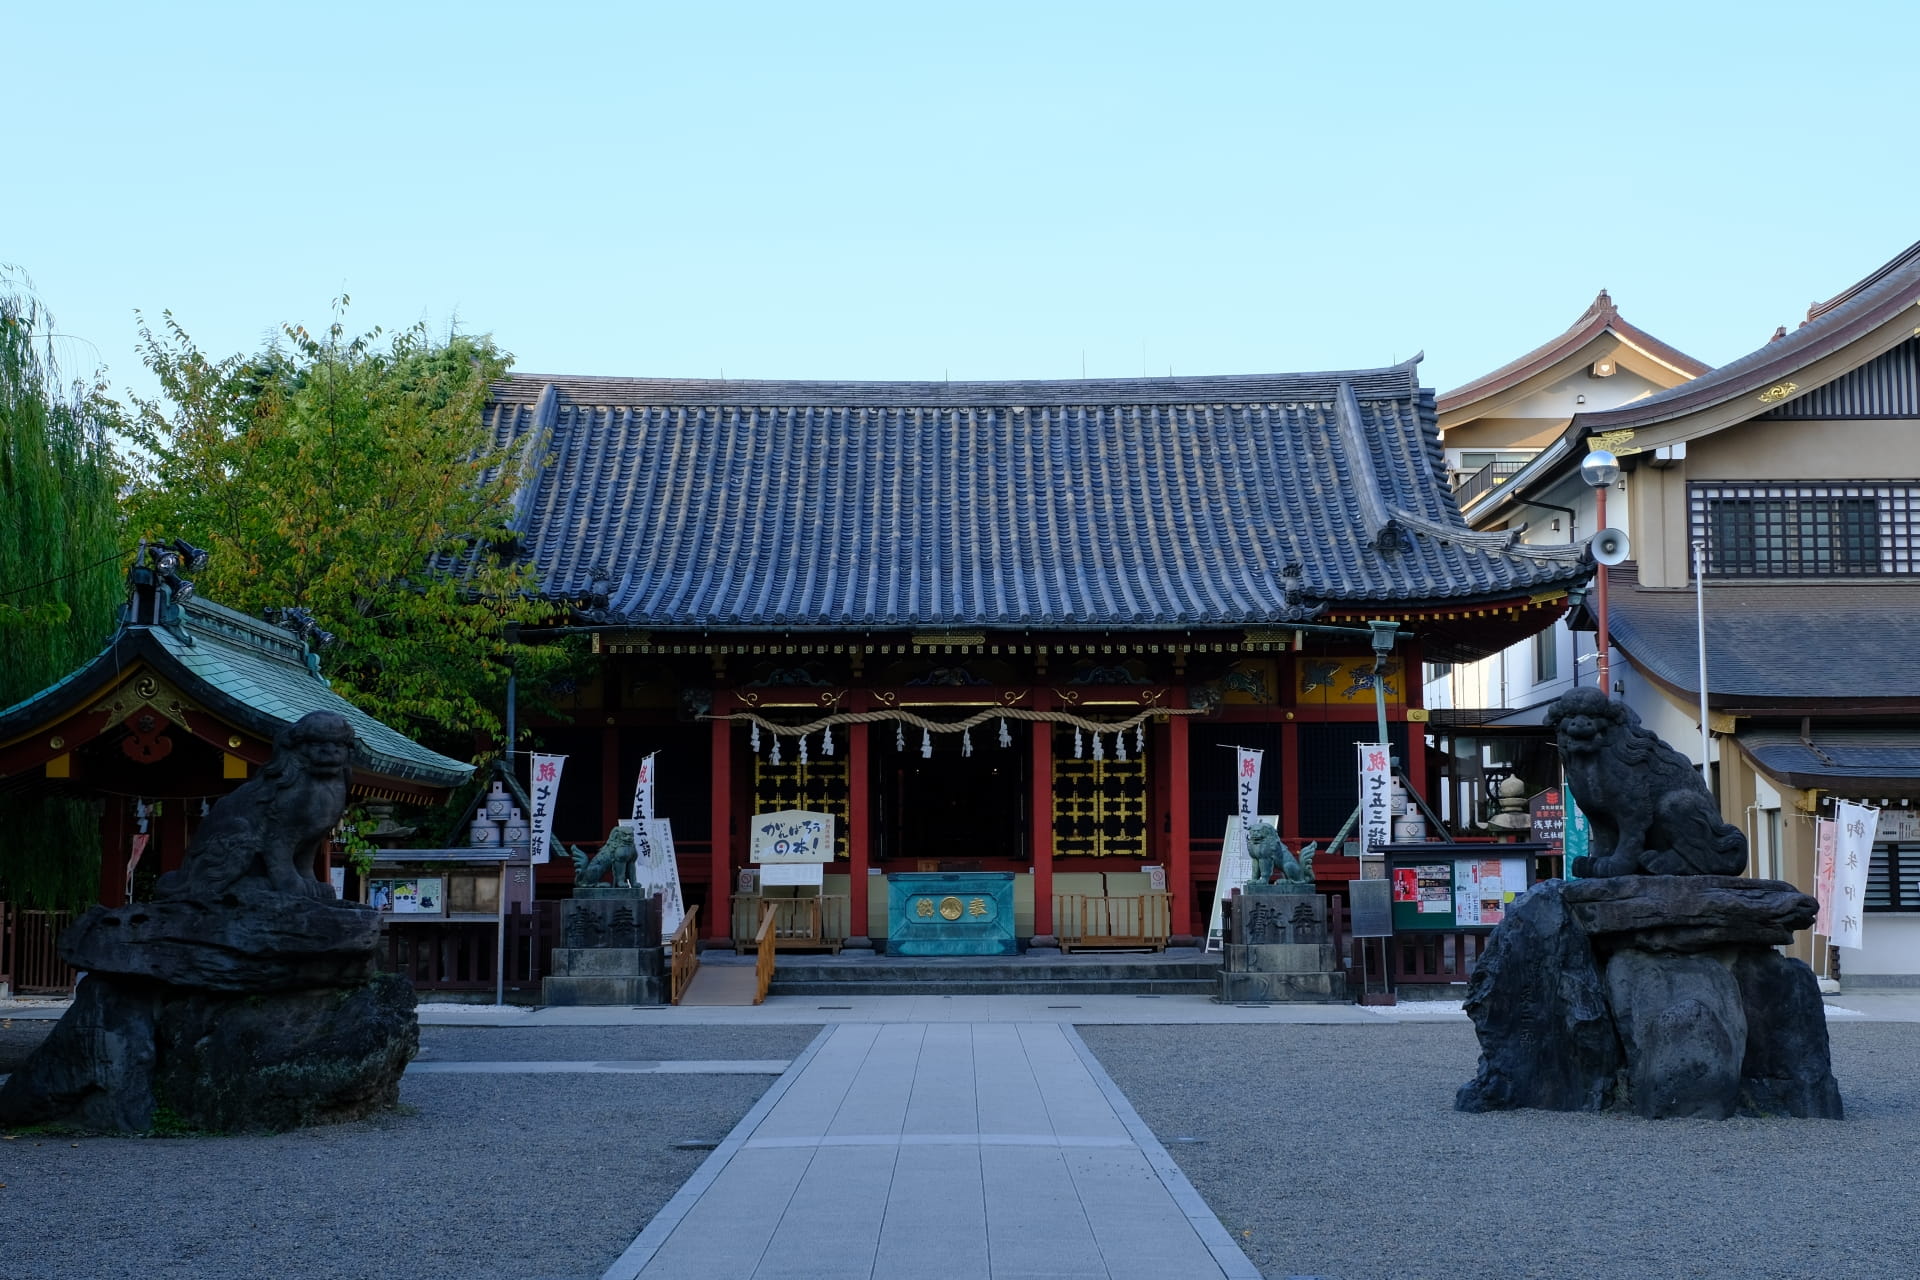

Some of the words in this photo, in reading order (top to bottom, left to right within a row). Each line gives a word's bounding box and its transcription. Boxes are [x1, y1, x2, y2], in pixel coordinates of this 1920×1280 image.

[761, 820, 821, 839] がんばろう
[1533, 819, 1563, 830] 浅草神
